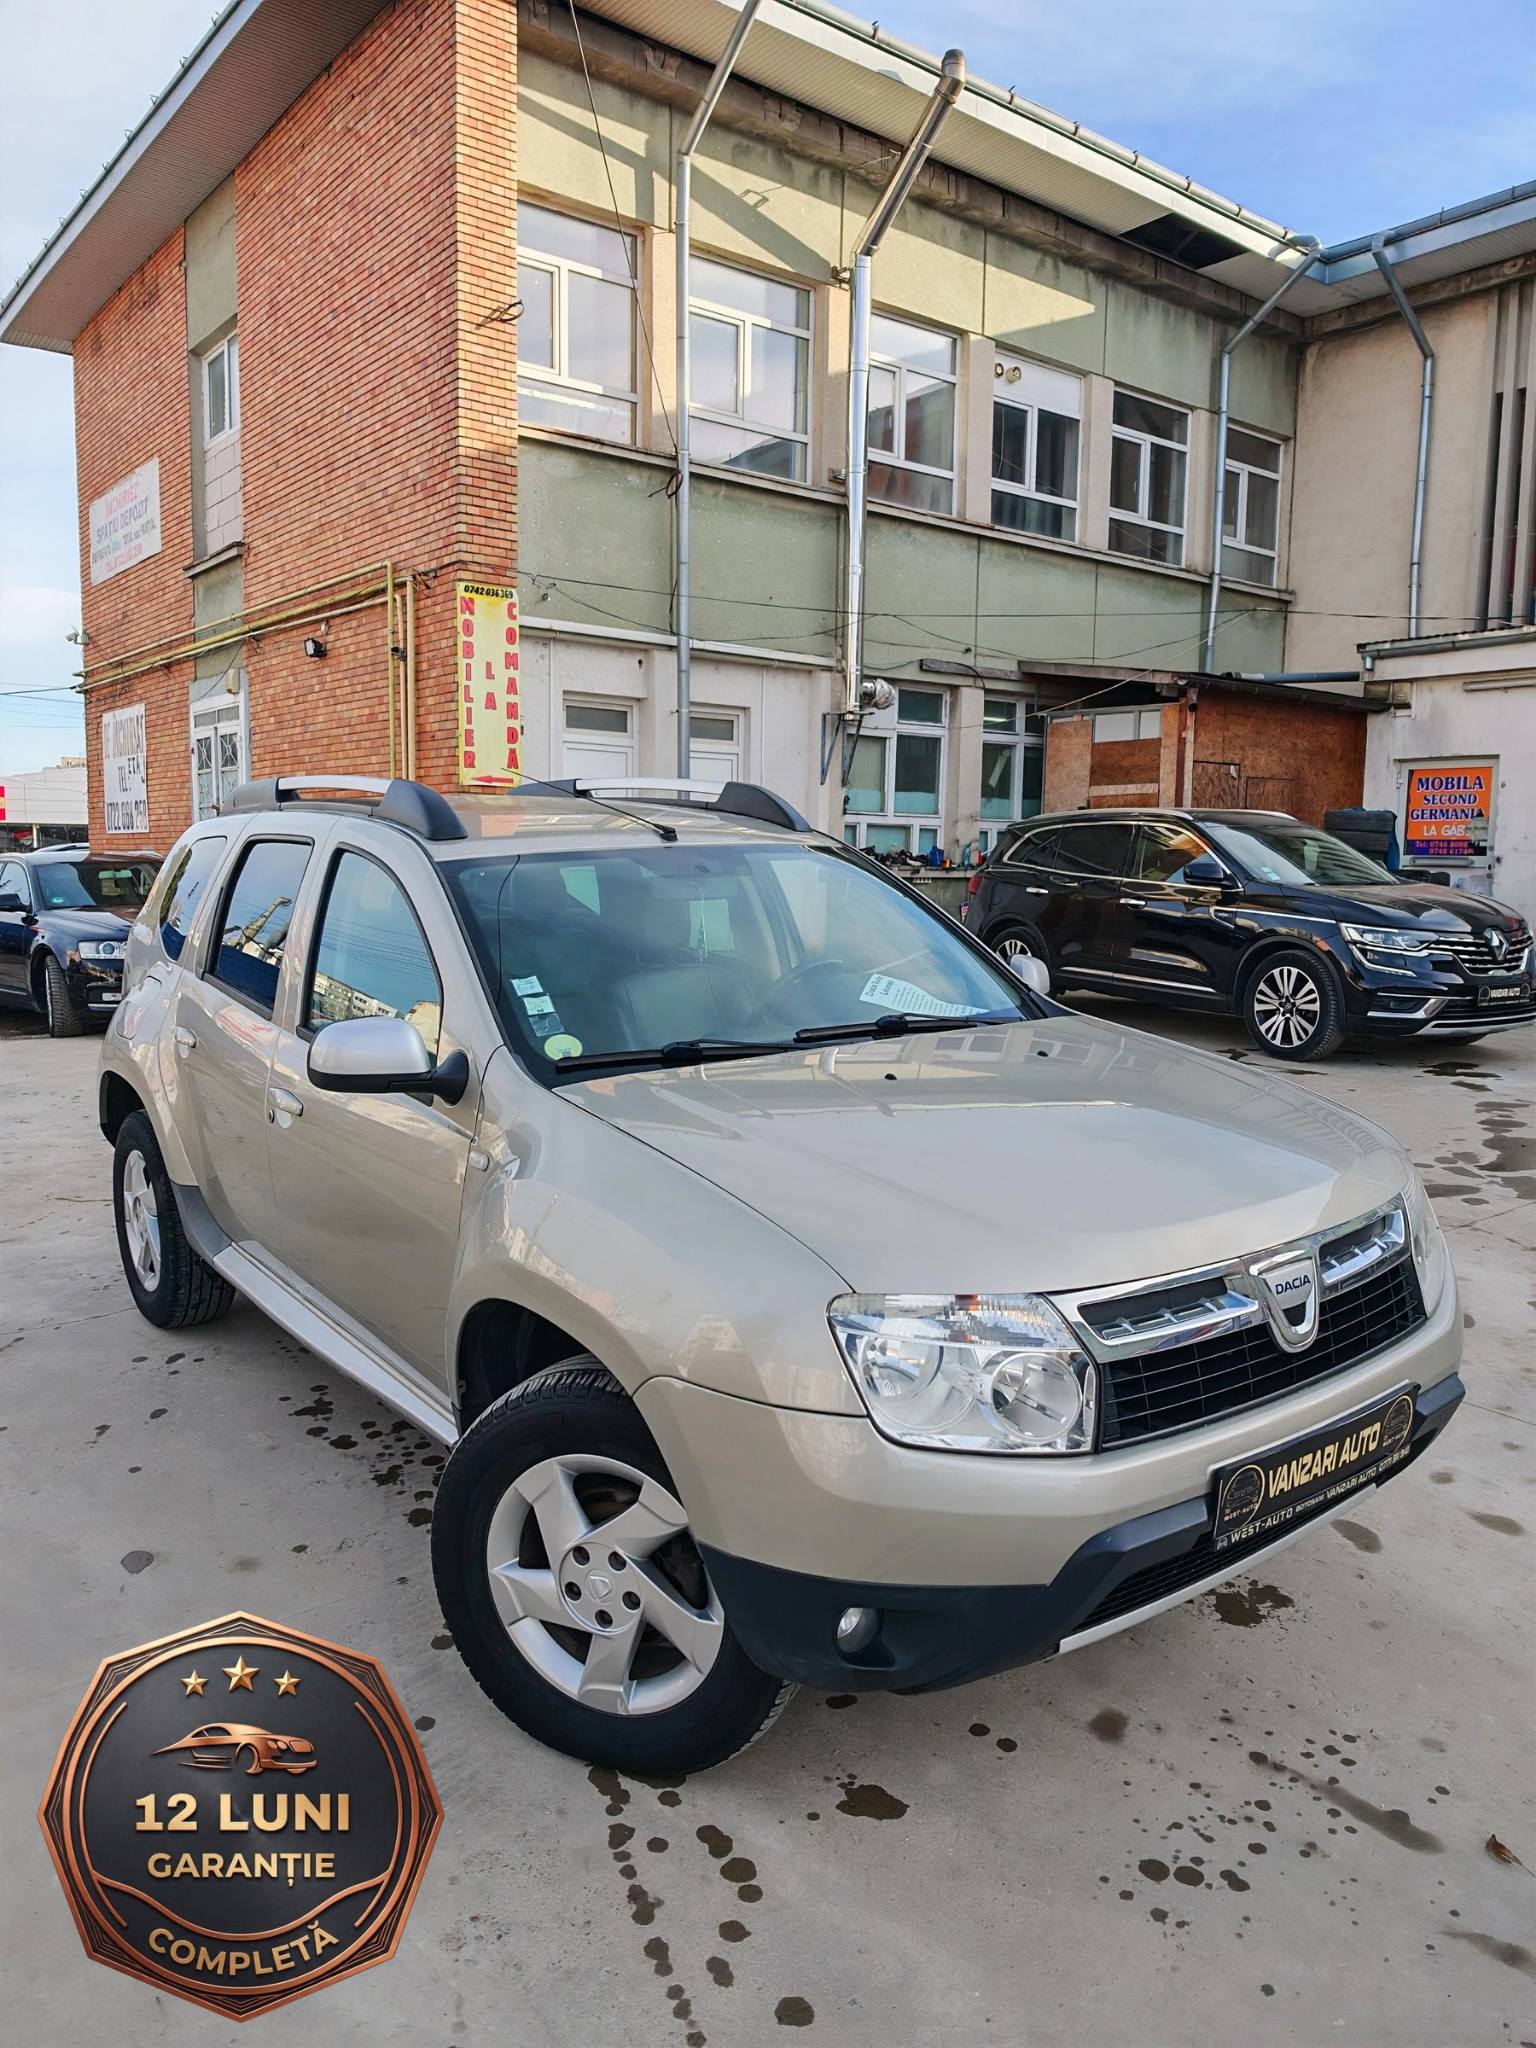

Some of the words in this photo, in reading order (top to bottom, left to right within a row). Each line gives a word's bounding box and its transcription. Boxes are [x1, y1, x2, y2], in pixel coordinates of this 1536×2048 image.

[464, 584, 485, 595] 0742
[485, 588, 499, 597] 036
[500, 590, 513, 598] 369
[484, 661, 497, 711] LA
[1417, 776, 1484, 791] MOBILA
[1423, 794, 1478, 806] SECOND
[1411, 808, 1485, 820] GERMANIA
[1423, 825, 1438, 836] LA
[1275, 1275, 1311, 1295] DACIA
[1269, 1441, 1339, 1498] VANZARI
[1338, 1421, 1381, 1468] AUTO
[1231, 1508, 1293, 1543] WEST-AUTO
